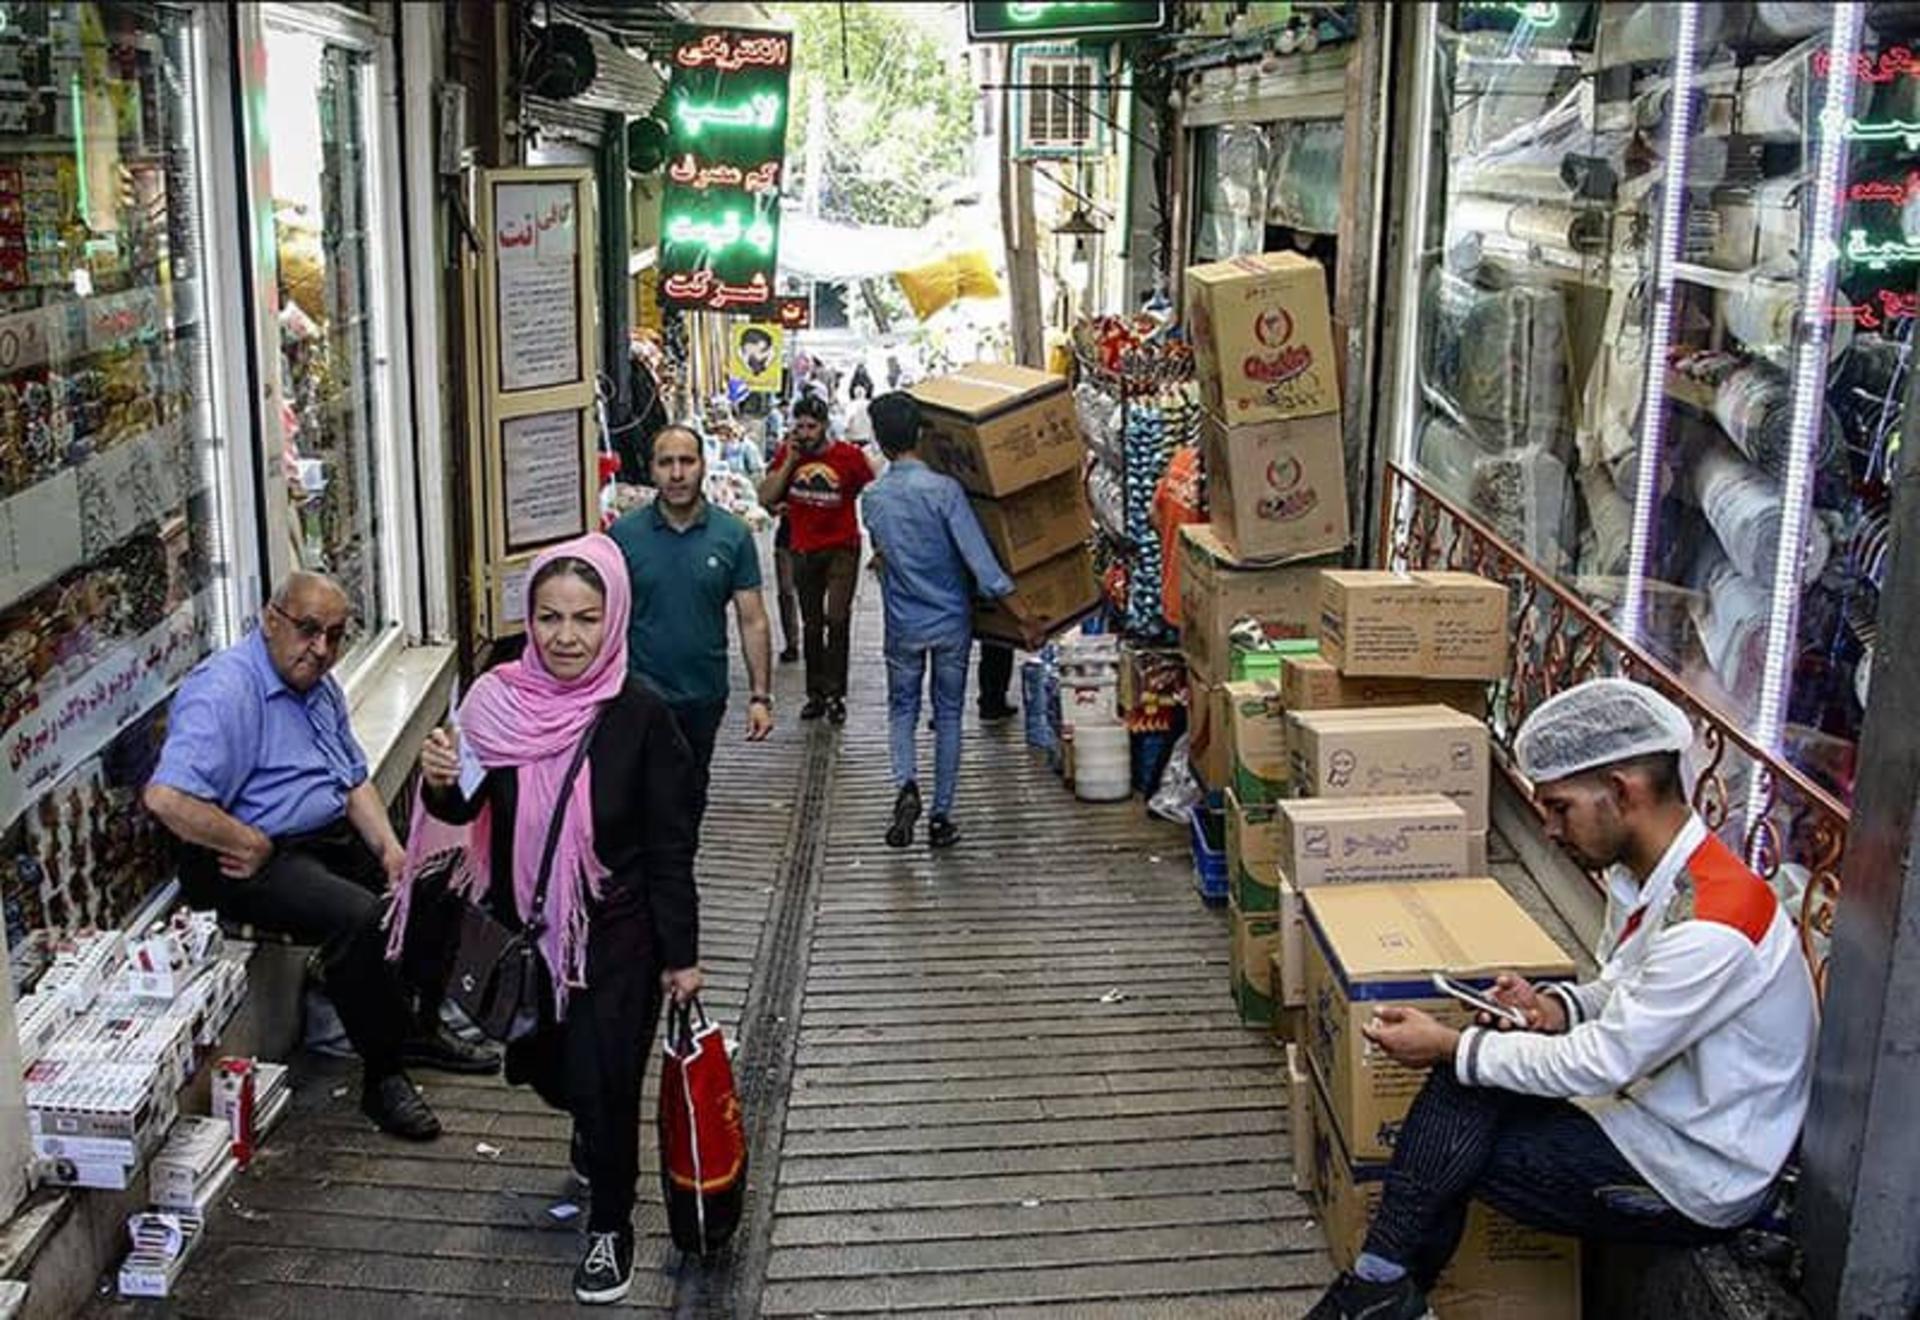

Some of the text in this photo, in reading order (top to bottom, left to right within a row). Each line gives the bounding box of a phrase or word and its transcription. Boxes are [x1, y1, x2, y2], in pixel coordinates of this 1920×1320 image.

[677, 35, 788, 70] الکتریکی
[677, 92, 780, 136] لامپ
[670, 153, 779, 191] کم مصرف
[665, 270, 770, 307] شرکت
